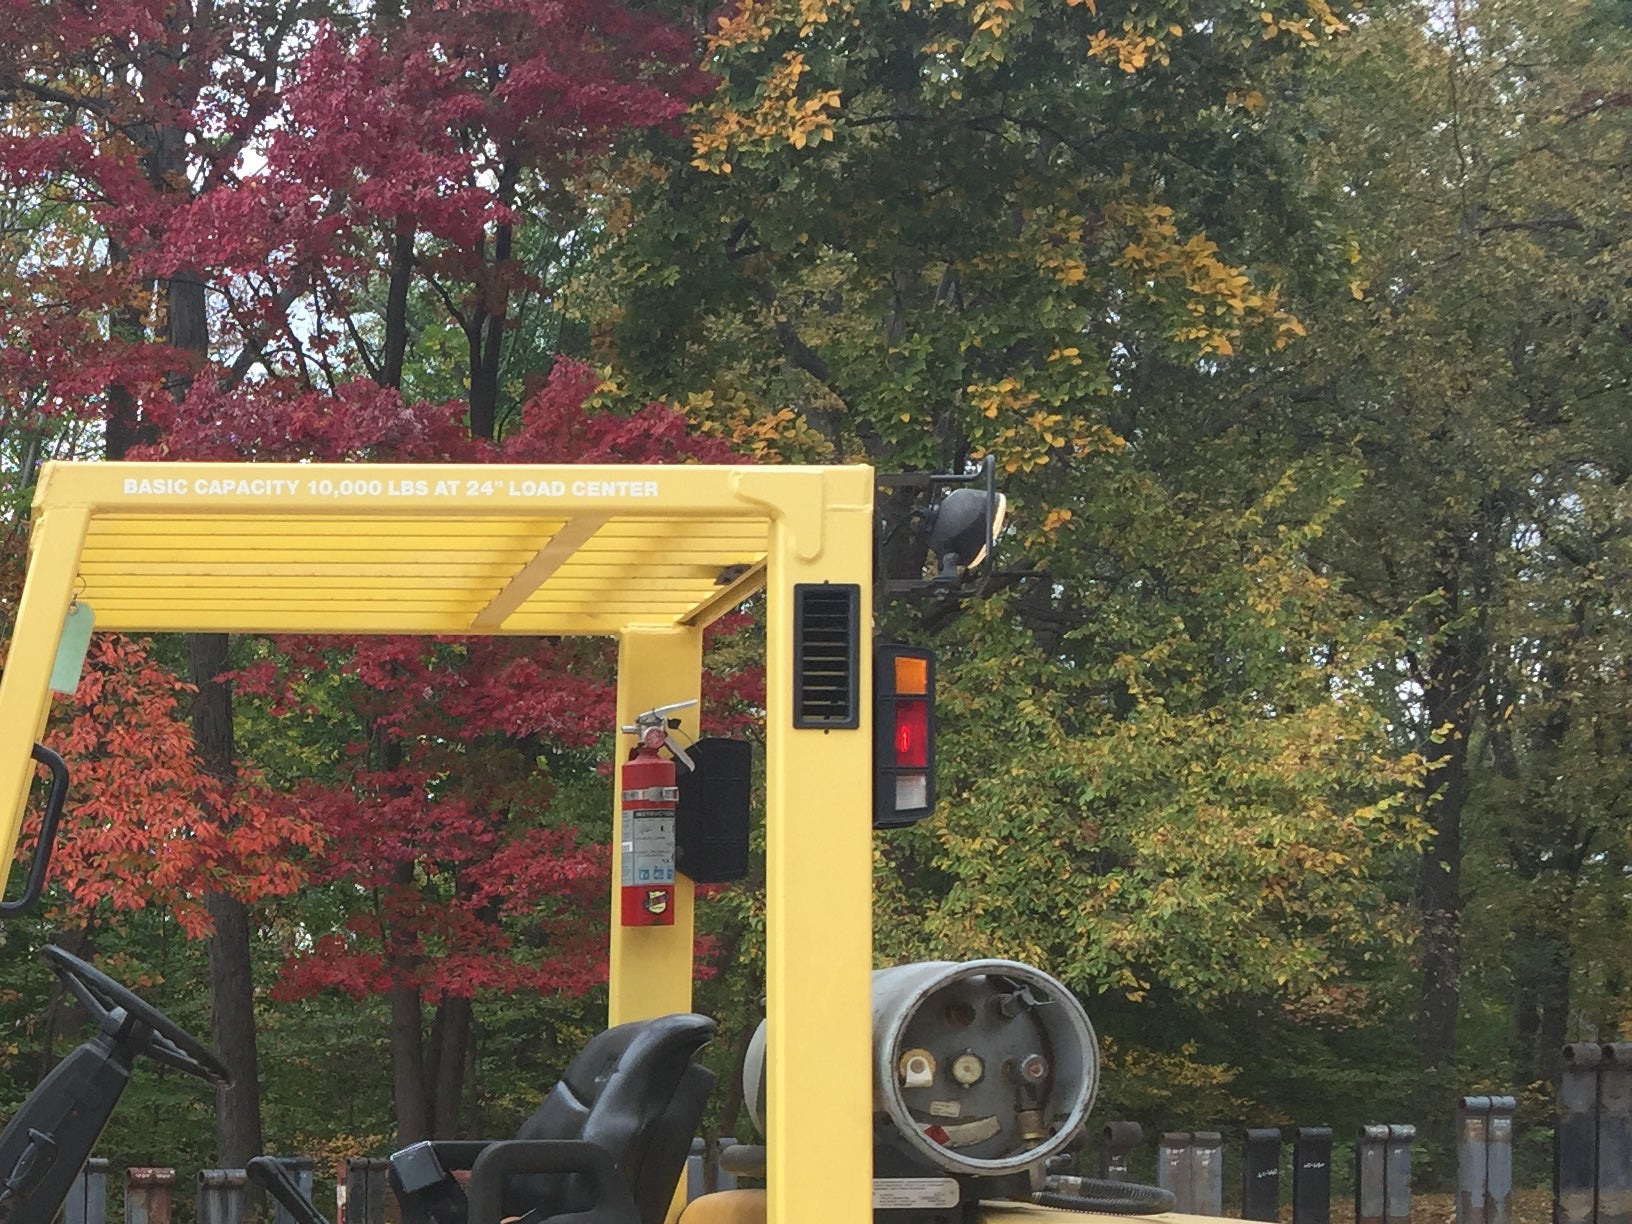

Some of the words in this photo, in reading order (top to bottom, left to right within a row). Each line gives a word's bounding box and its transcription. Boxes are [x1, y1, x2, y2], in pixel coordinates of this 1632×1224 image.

[123, 479, 188, 495] BASIC
[194, 479, 300, 496] CAPACITY
[307, 479, 382, 498] 10,000
[388, 480, 429, 496] LBS
[434, 480, 460, 496] AT
[509, 480, 566, 496] LOAD
[571, 481, 659, 497] CENTER
